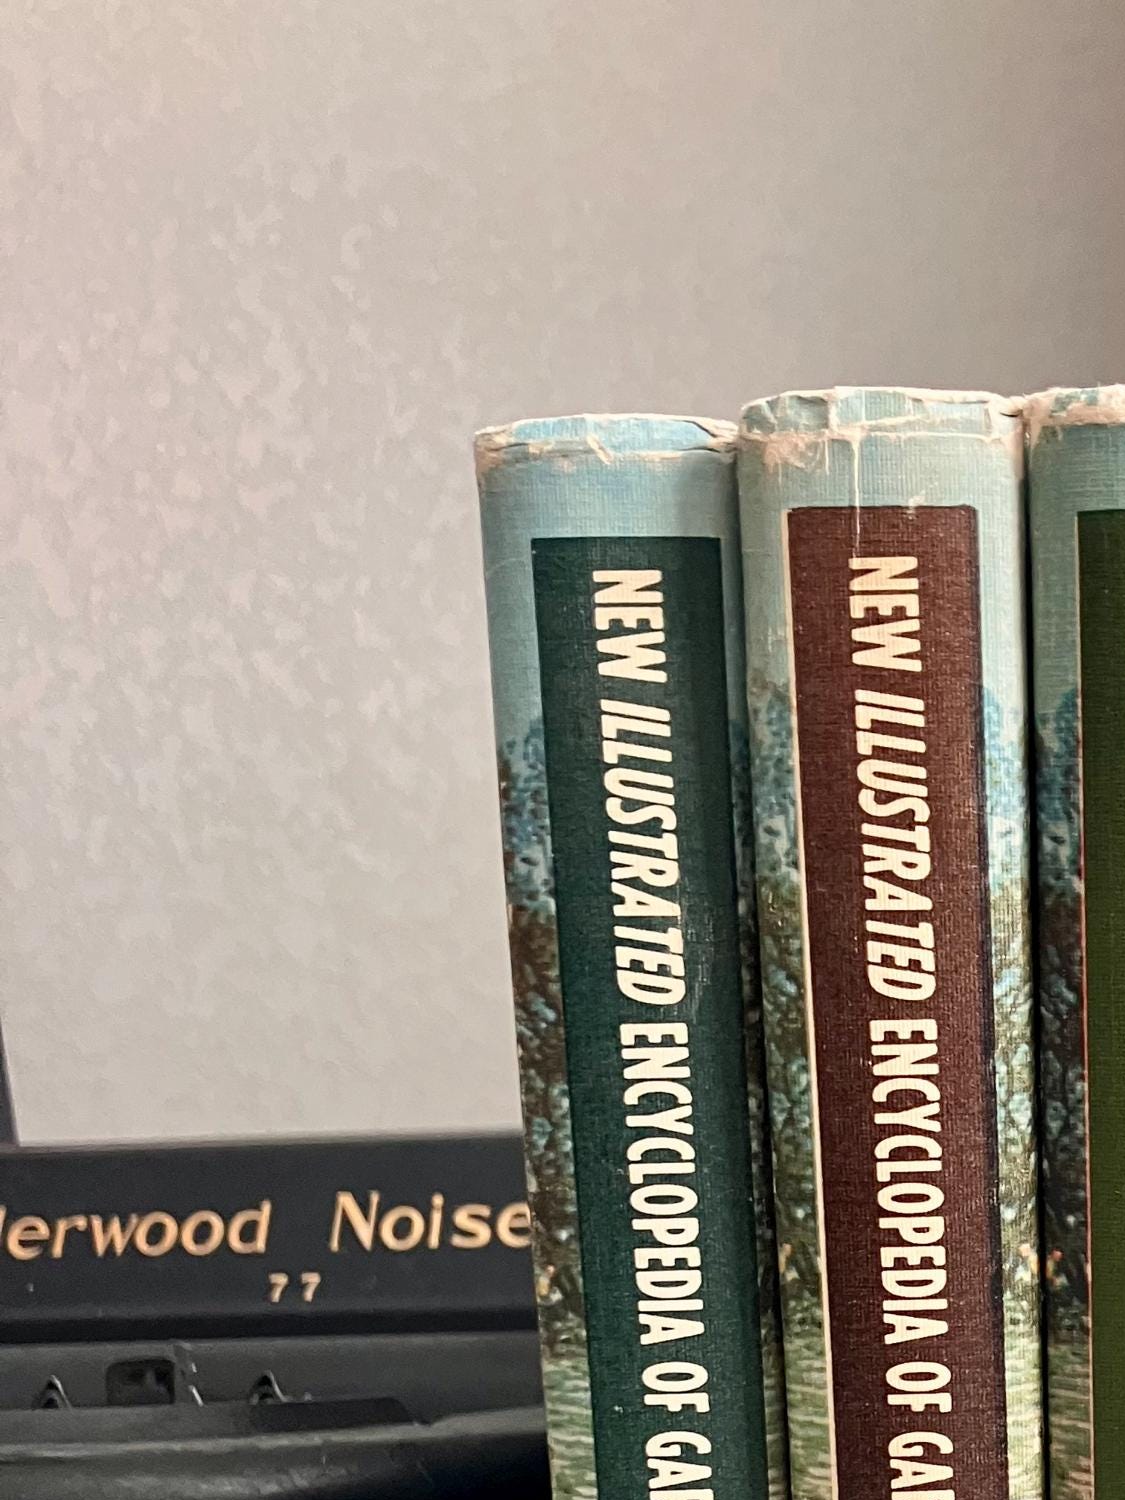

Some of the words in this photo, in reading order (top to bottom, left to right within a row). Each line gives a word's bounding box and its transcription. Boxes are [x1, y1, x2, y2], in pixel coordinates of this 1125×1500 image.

[592, 569, 668, 684] NEW
[848, 552, 923, 673] NEW
[600, 698, 686, 1006] ILLUSTRATED
[854, 689, 937, 1001] ILLUSTRATED
[0, 1200, 272, 1260] erwood
[619, 1022, 705, 1345] ENCYCLOPEDIA
[869, 1018, 949, 1345] ENCYCLOPEDIA
[641, 1361, 710, 1413] OF
[885, 1361, 953, 1413] OF
